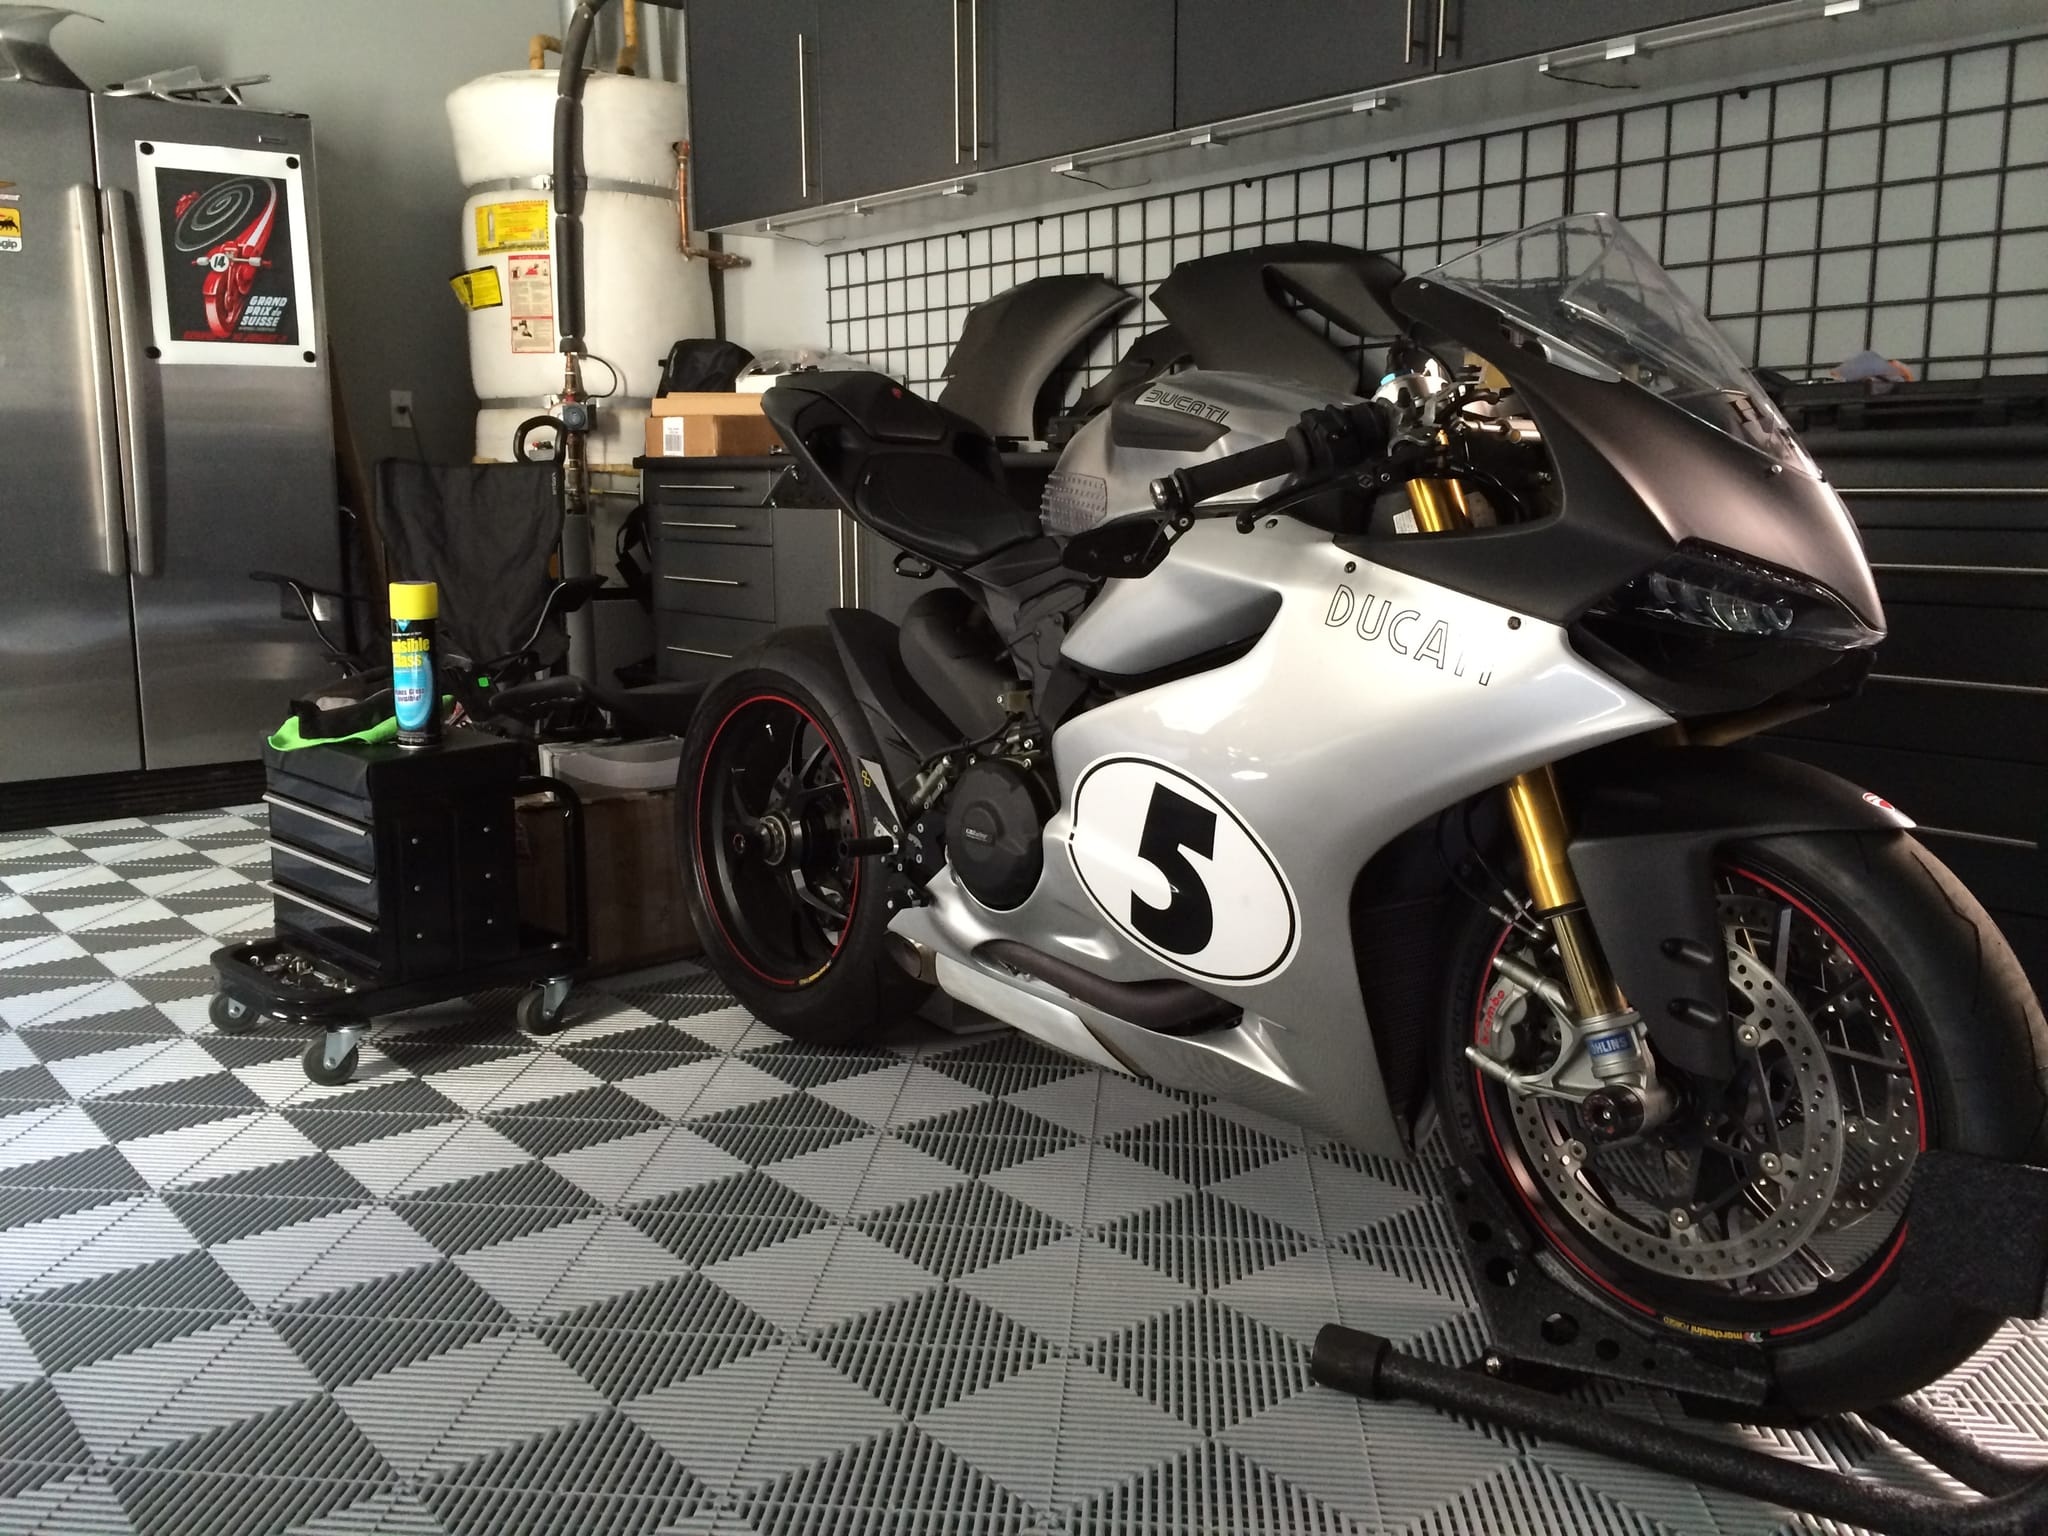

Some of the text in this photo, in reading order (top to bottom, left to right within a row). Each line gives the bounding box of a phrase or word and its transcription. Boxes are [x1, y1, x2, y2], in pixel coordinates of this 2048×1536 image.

[213, 255, 226, 268] 14
[249, 295, 288, 307] GRAND
[244, 305, 272, 316] PRIX
[239, 315, 280, 327] SUISSE
[1143, 389, 1230, 424] DUCATI
[1131, 782, 1218, 955] 5
